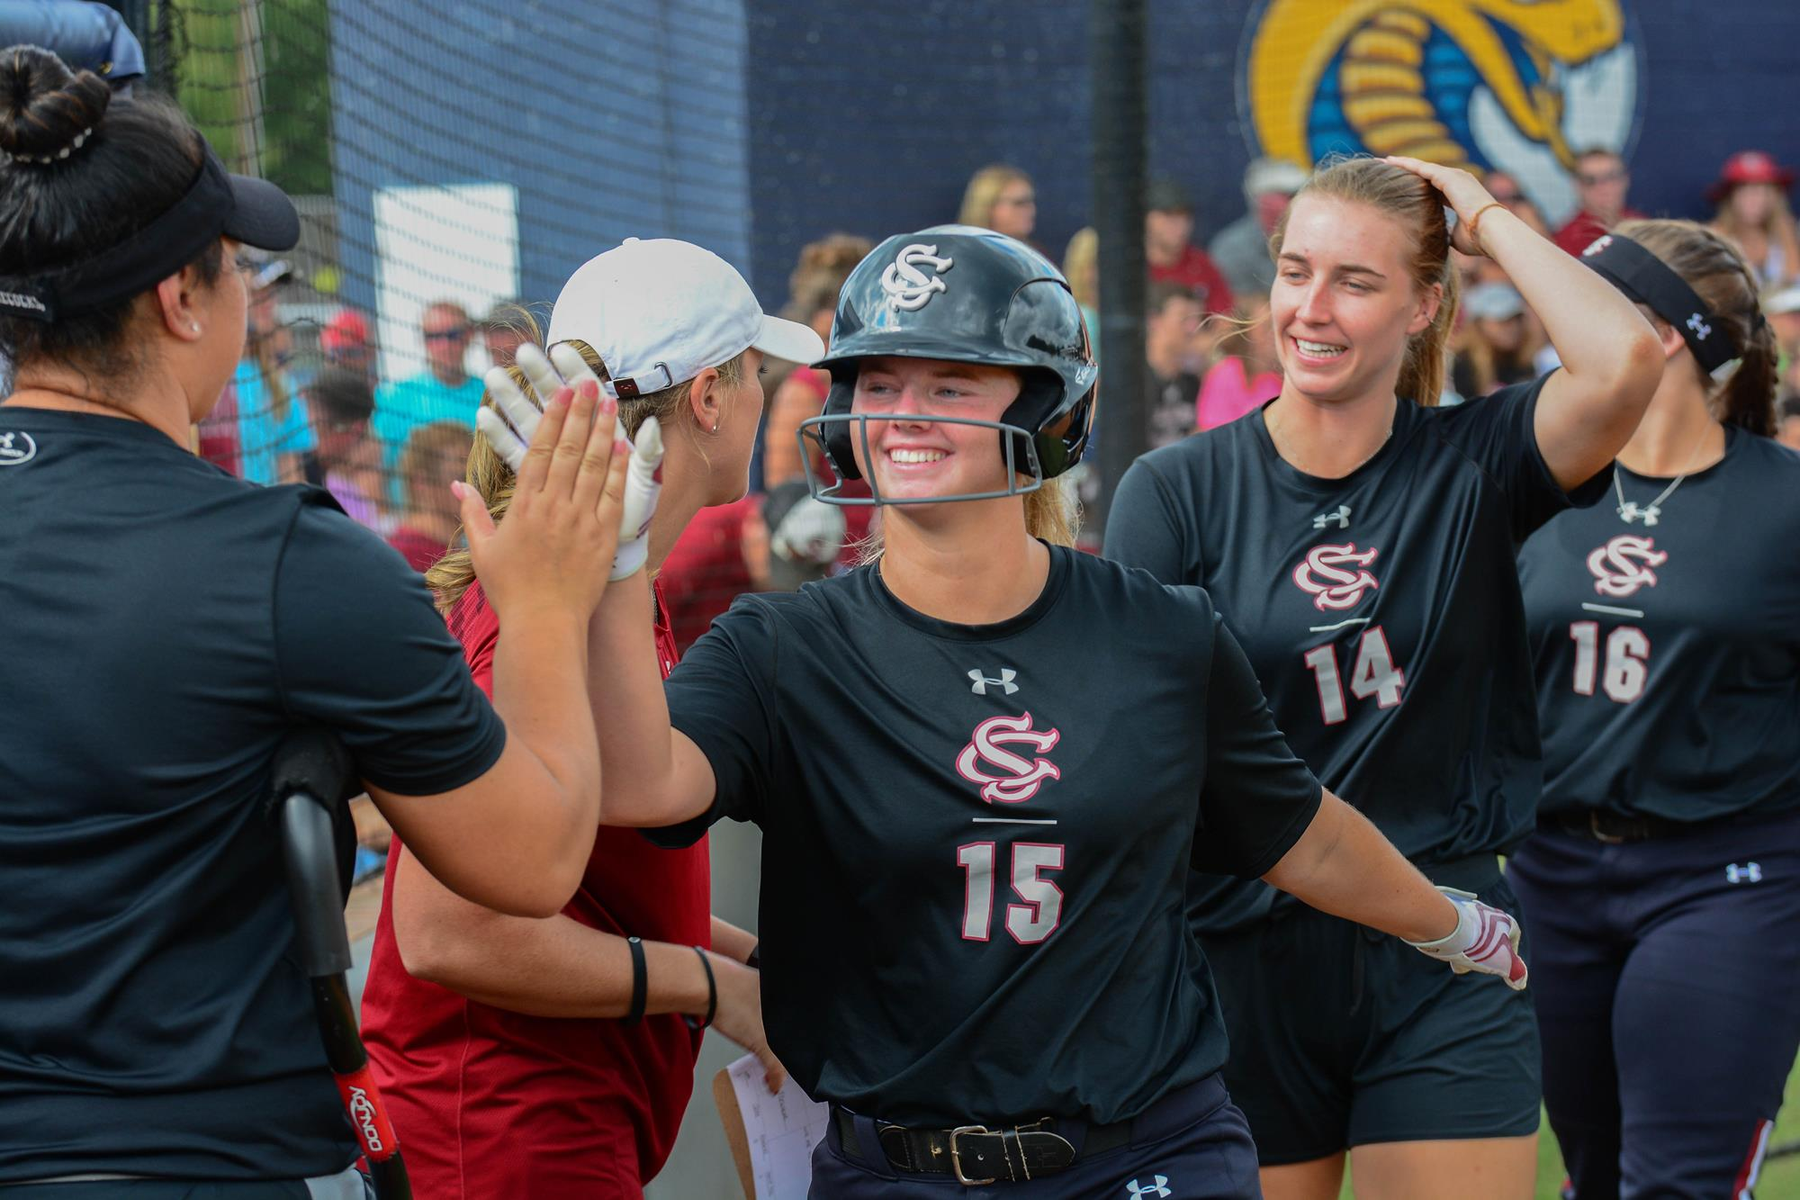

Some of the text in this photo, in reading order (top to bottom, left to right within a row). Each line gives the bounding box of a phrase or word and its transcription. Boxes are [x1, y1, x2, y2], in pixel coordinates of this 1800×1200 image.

[1304, 625, 1405, 726] 14
[1570, 620, 1650, 703] 16
[957, 842, 1065, 945] 15
[348, 1085, 383, 1152] DONJOY
